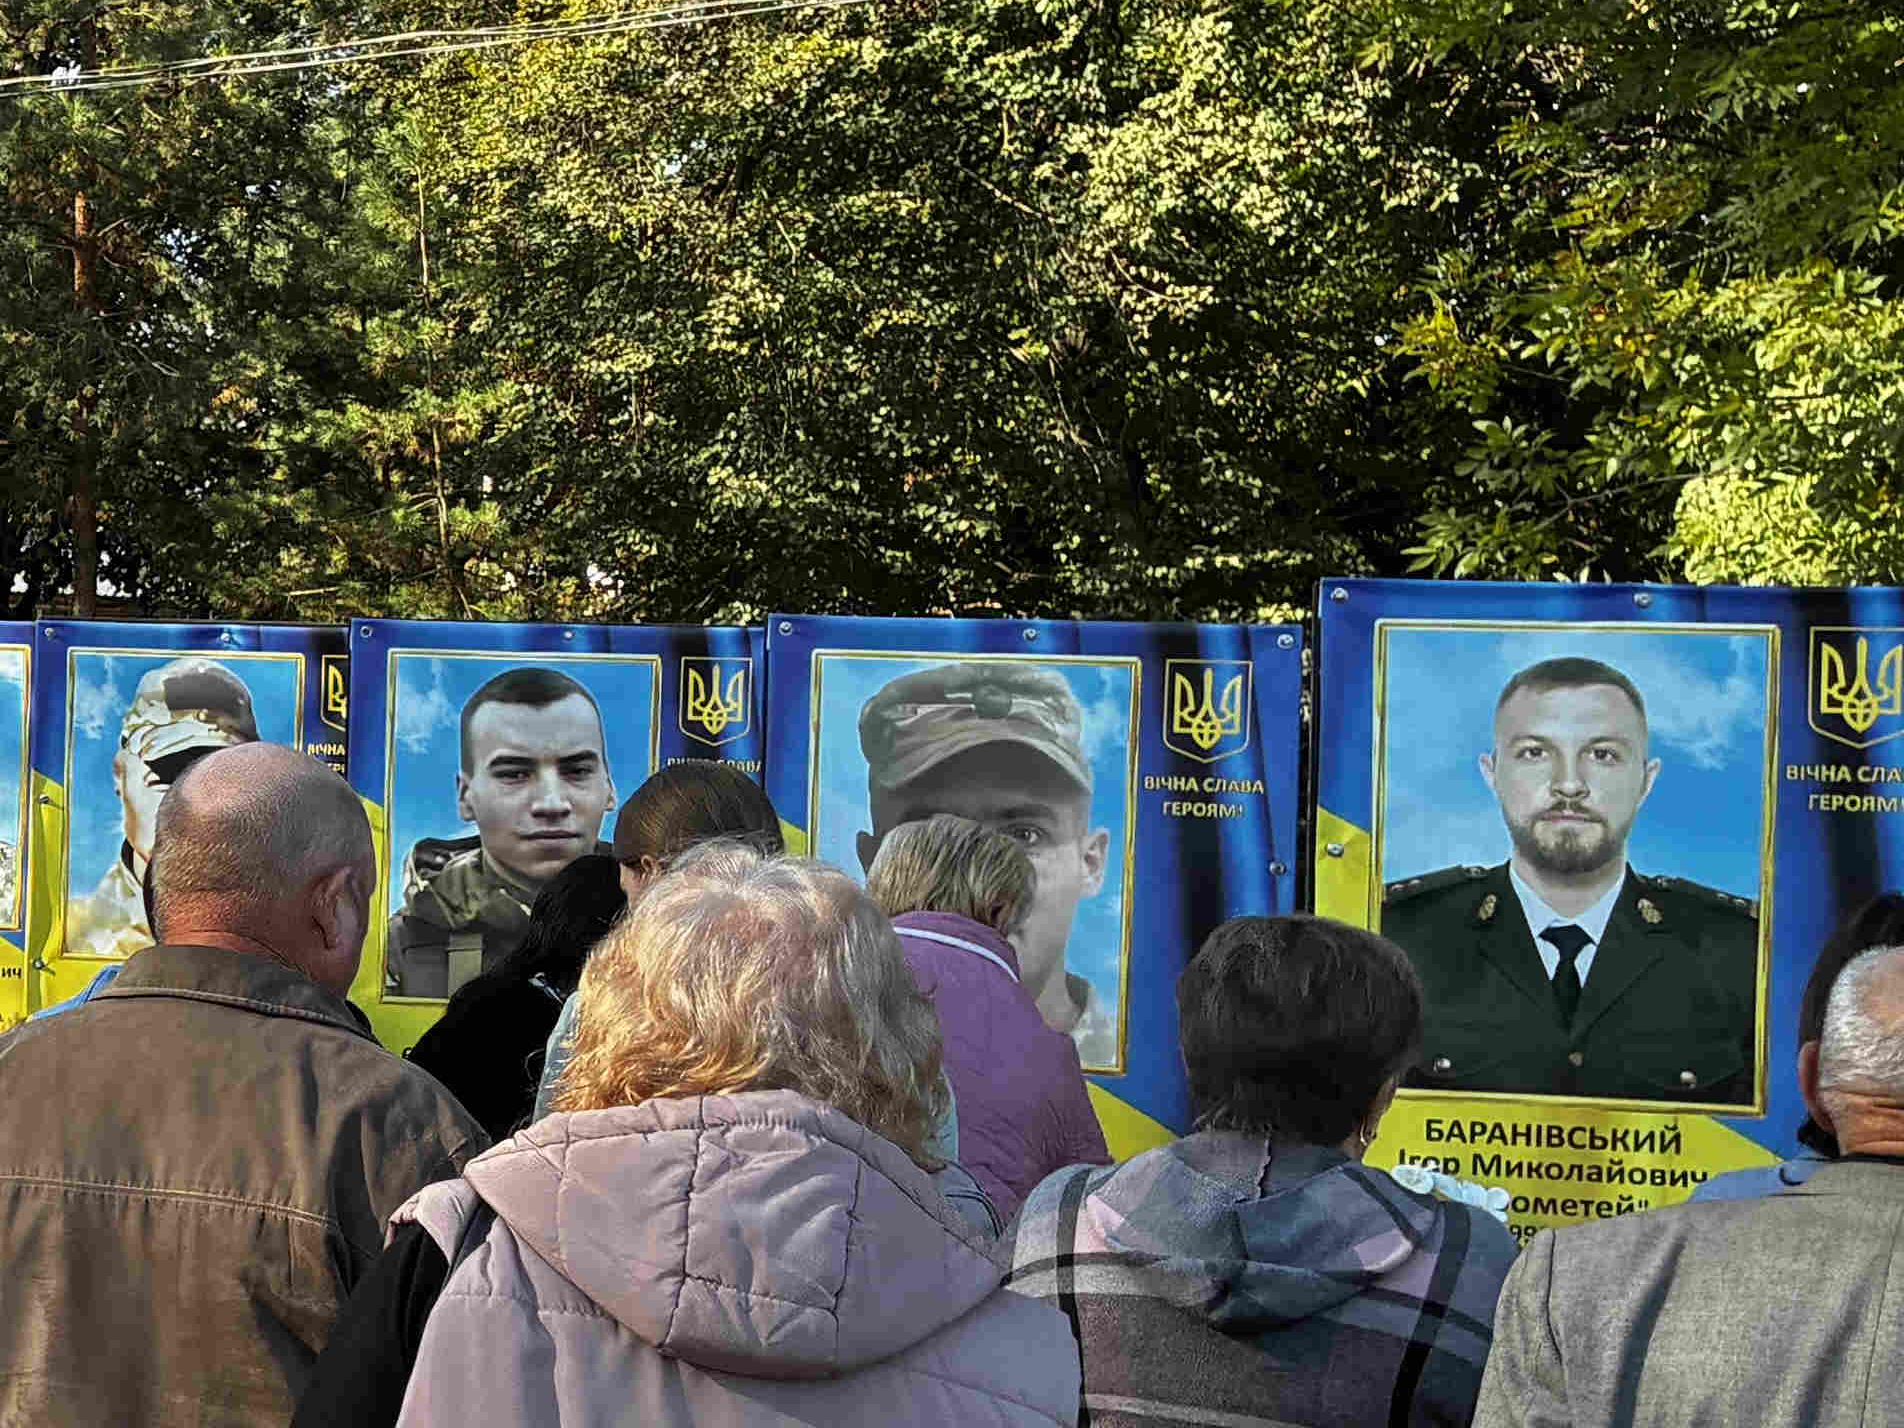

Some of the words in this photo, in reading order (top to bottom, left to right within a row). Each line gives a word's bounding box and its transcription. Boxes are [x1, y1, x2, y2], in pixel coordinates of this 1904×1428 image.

[1786, 764, 1852, 782] ВІЧНА
[1144, 775, 1199, 792] ВІЧНА
[1202, 777, 1264, 794] СЛАВА
[1162, 801, 1243, 818] ГЕРОЯМ!
[1425, 1118, 1681, 1155] БАРАНІВСЬКИЙ
[1471, 1152, 1708, 1188] Миколайович
[1504, 1194, 1649, 1219] ометей"
